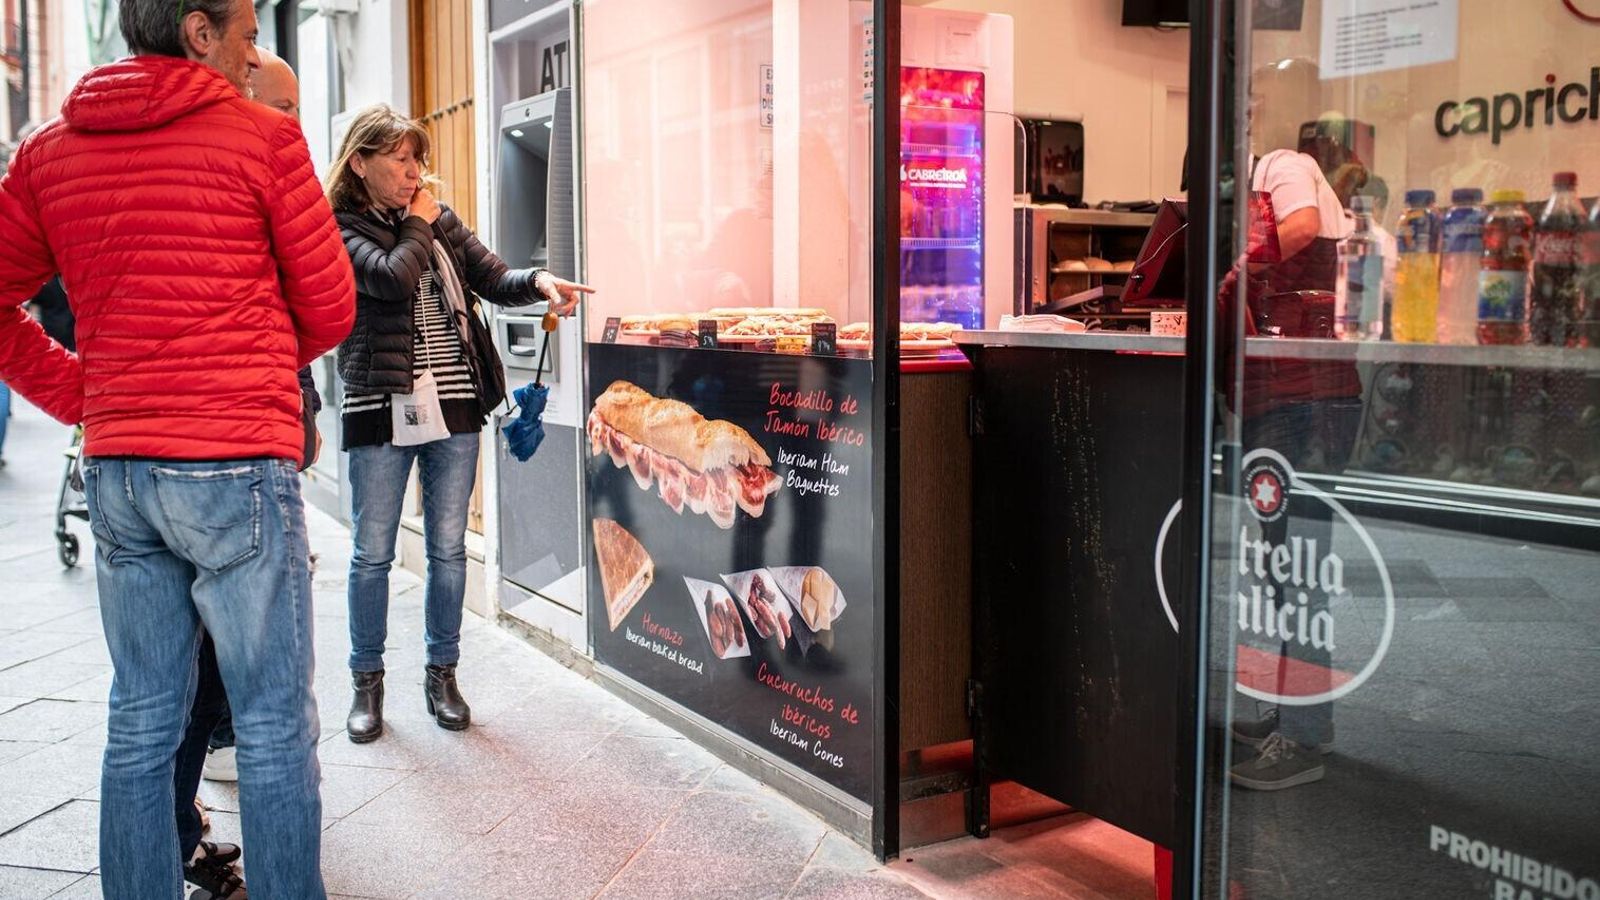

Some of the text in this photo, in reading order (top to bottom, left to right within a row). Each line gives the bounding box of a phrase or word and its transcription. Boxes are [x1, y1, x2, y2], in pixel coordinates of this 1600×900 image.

[540, 39, 571, 94] AT
[769, 382, 858, 415] Bocadillo de
[764, 410, 865, 446] Jamón Ibérico
[777, 446, 850, 476] Iberiam Ham
[786, 469, 840, 496] Baguettes
[1238, 525, 1346, 595] trella
[642, 612, 684, 646] Hornazo
[625, 626, 651, 650] Iberian
[679, 653, 703, 675] bread
[757, 662, 859, 724] Cucuruchos de
[781, 704, 832, 739] ibéricos
[769, 718, 844, 768] Iberiam Cones
[1430, 825, 1600, 900] PROHIBIDO
